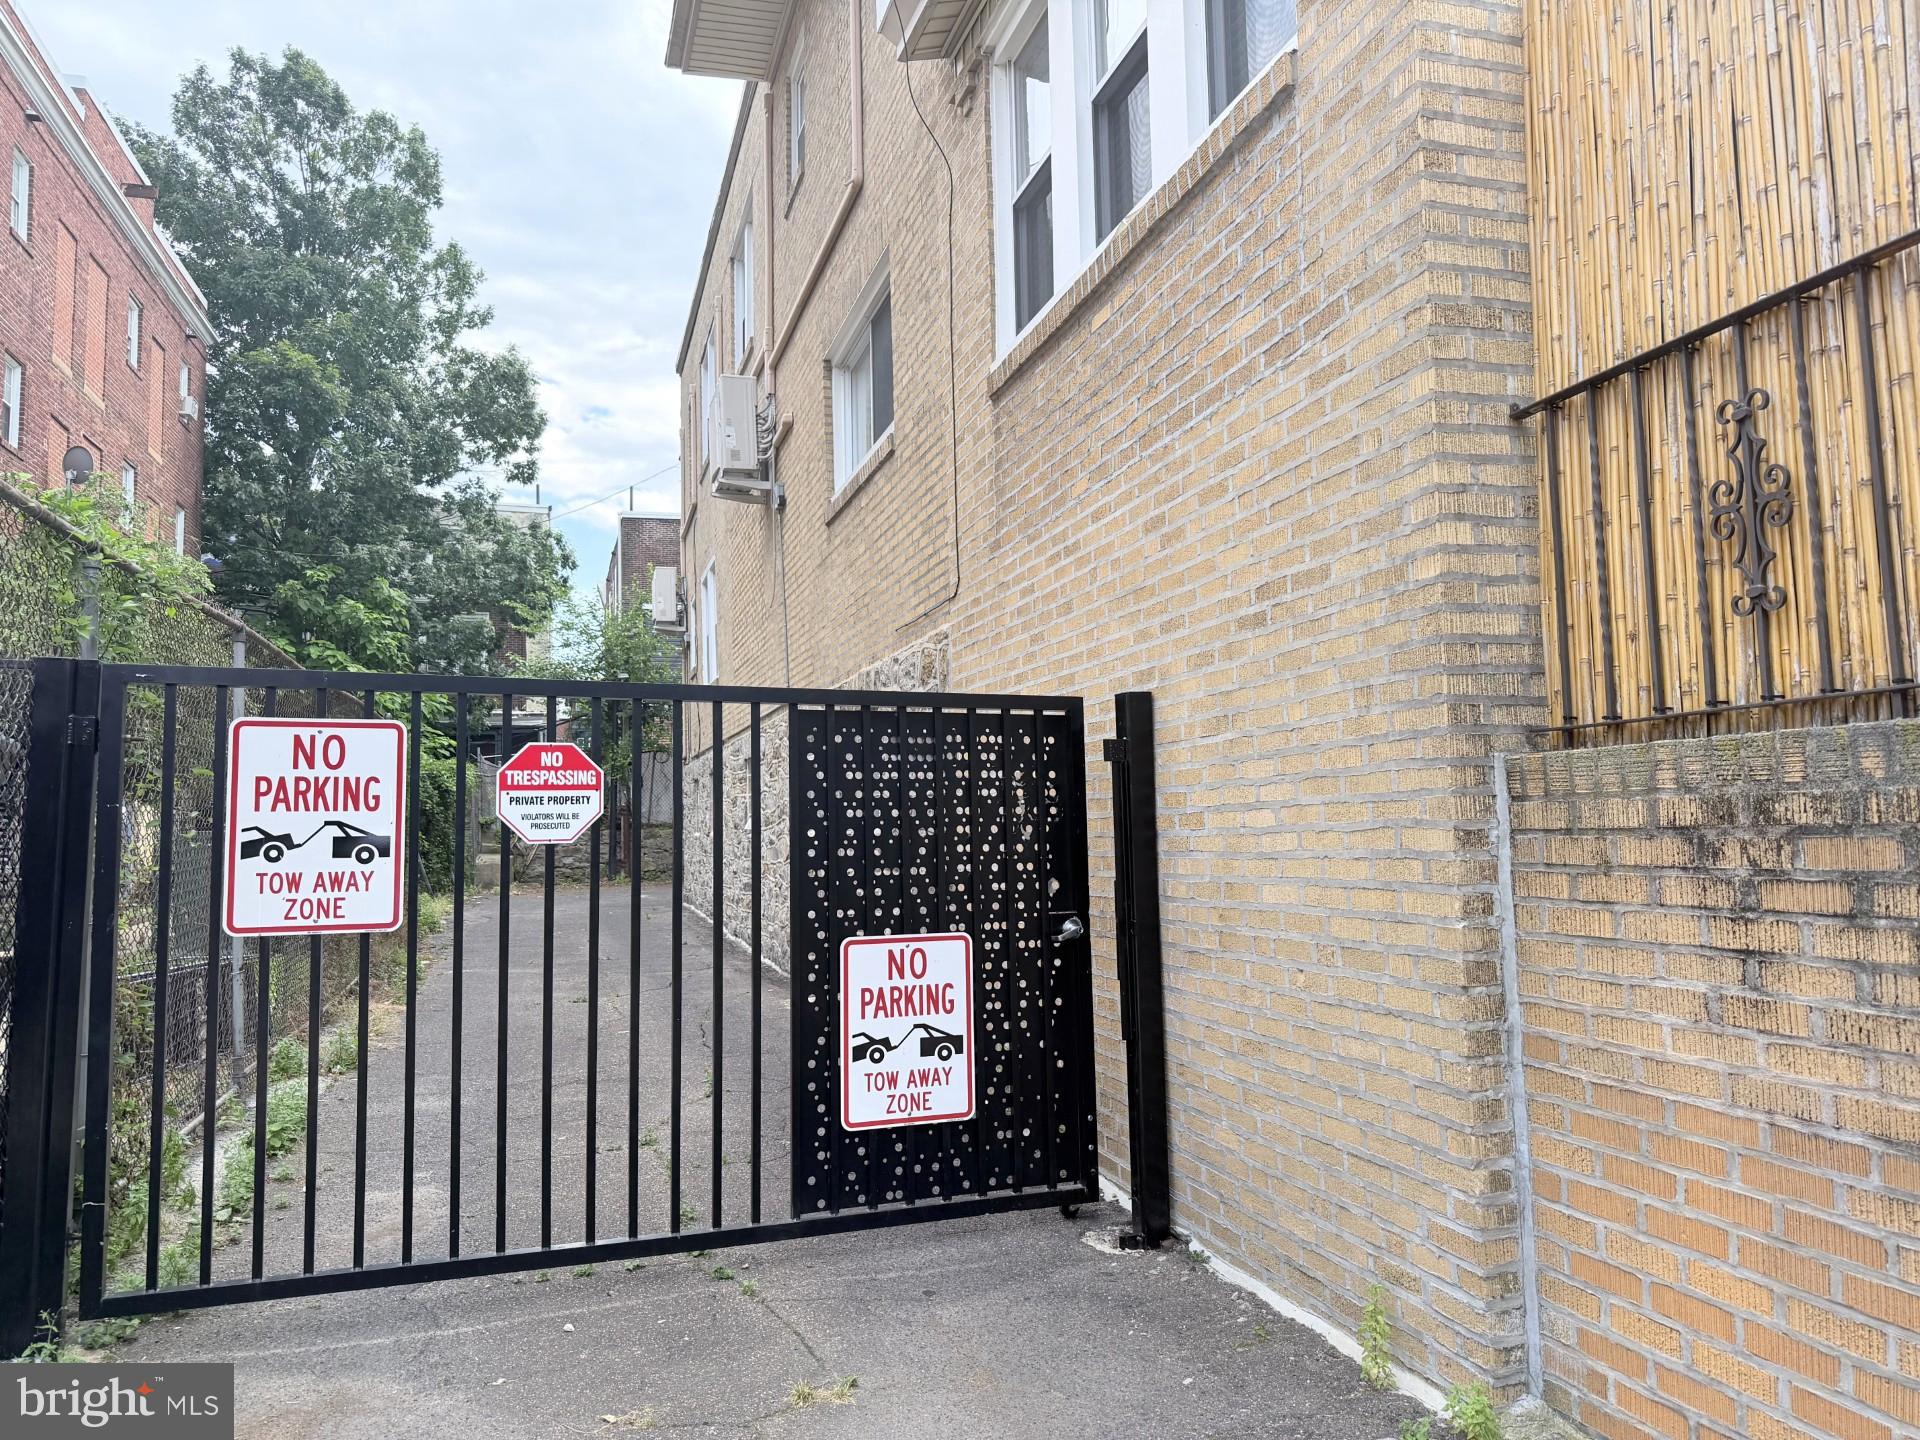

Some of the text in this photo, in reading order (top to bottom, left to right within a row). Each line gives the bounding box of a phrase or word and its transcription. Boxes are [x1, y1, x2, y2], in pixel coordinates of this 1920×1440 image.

[292, 733, 346, 770] NO
[540, 751, 563, 767] NO
[505, 770, 597, 785] TRESPASSING
[254, 776, 381, 812] PARKING
[509, 795, 591, 806] PRIVATE PROPERTY
[520, 813, 555, 821] VIOLATORS
[571, 812, 580, 820] BE
[530, 822, 570, 830] PROSECUTED
[255, 870, 375, 894] TOW AWAY
[283, 897, 346, 921] ZONE
[887, 947, 927, 980] NO
[860, 982, 955, 1020] PARKING
[864, 1066, 953, 1093] TOW AWAY
[886, 1091, 933, 1114] ZONE
